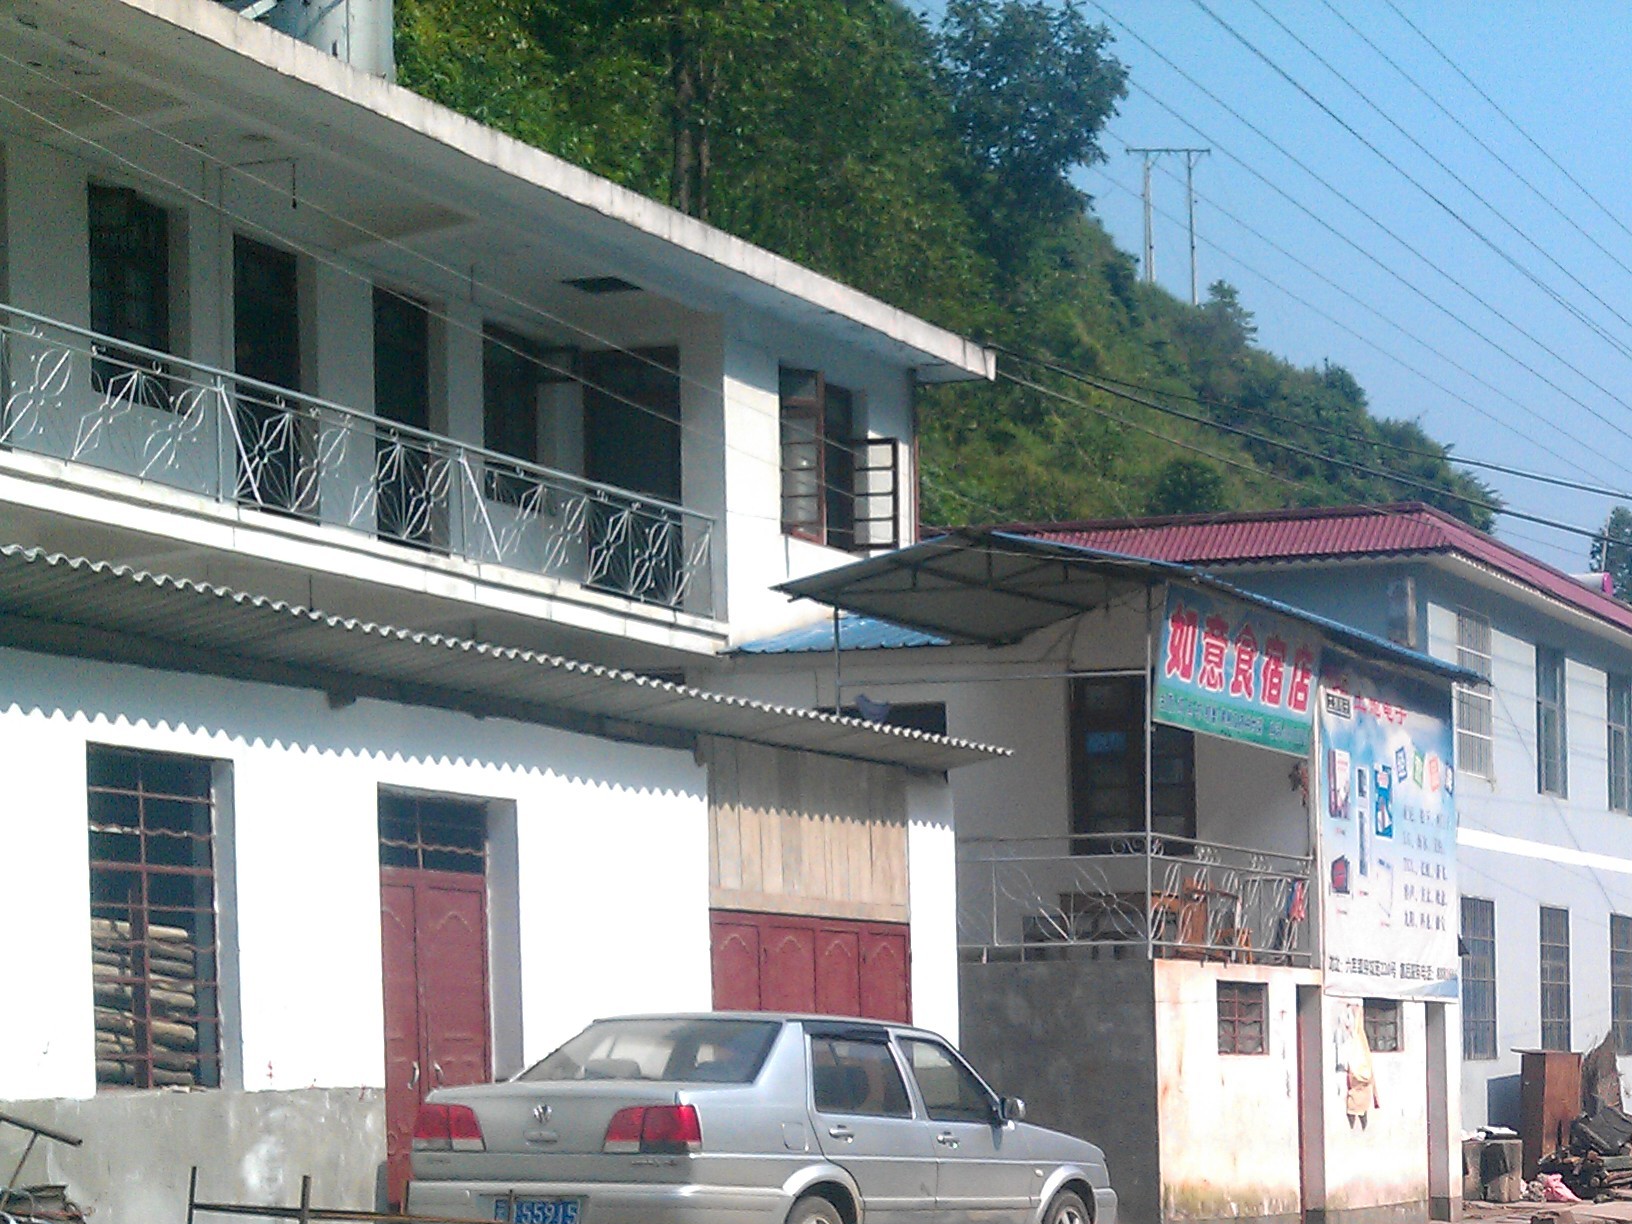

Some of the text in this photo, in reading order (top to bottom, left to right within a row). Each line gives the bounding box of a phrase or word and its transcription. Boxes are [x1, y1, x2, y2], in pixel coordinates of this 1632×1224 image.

[1165, 602, 1316, 714] 如意食宿店
